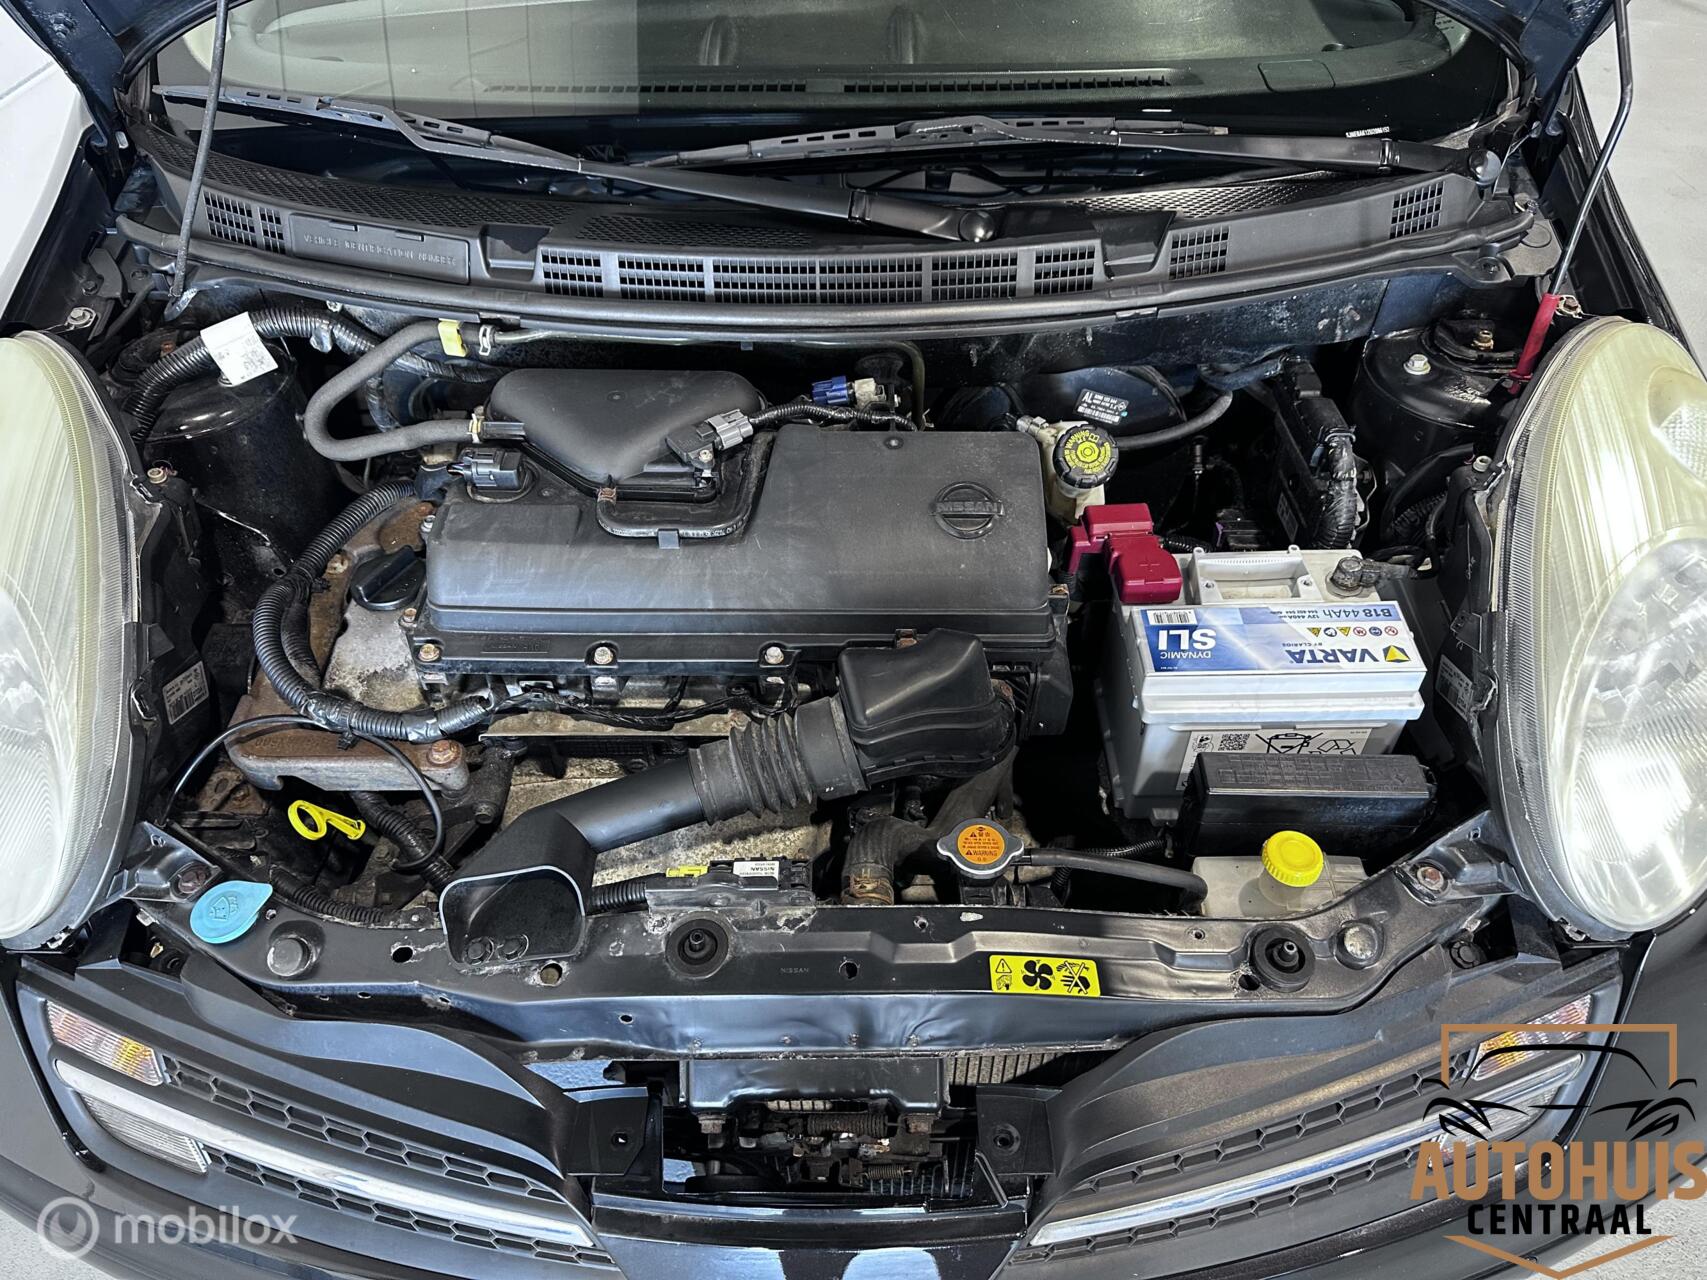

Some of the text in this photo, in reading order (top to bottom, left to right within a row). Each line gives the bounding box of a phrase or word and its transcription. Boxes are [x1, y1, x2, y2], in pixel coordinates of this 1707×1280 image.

[936, 500, 998, 512] NISSAN
[1322, 608, 1360, 618] 44Ah
[1362, 608, 1392, 618] B18
[1158, 628, 1217, 650] SLI
[1160, 650, 1212, 660] DYNAMIC
[1285, 648, 1380, 664] VARTA
[972, 849, 998, 857] WARNING
